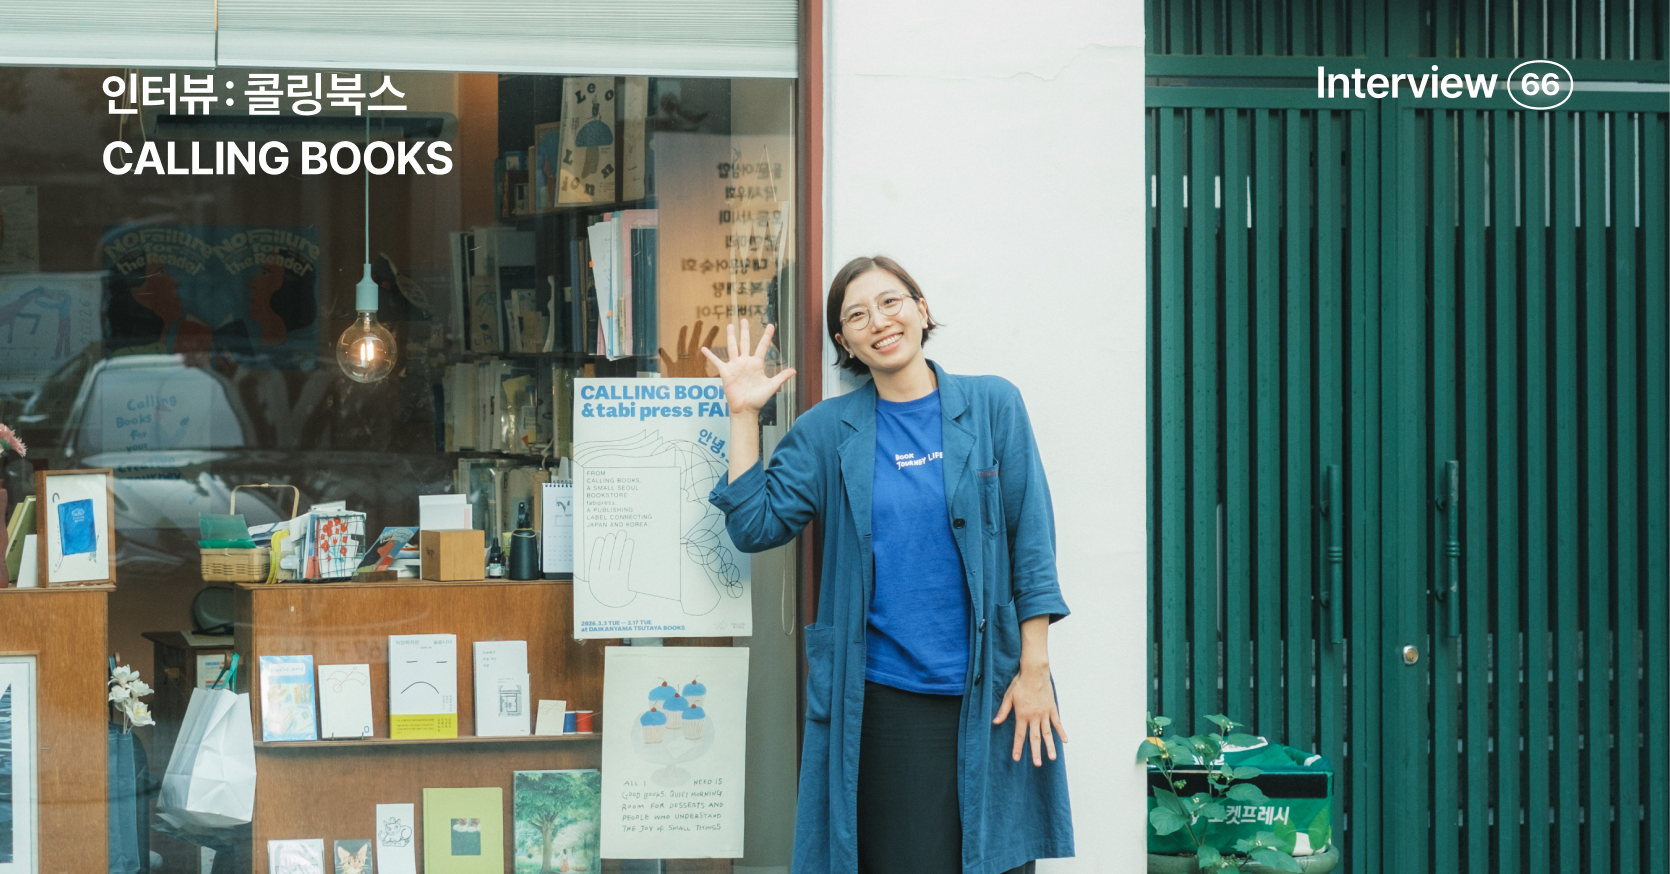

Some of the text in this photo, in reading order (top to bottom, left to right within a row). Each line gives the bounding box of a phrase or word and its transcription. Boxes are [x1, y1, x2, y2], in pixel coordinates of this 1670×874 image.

[575, 82, 614, 104] Leo
[144, 241, 181, 252] for
[116, 256, 146, 276] the
[224, 256, 253, 276] the
[581, 385, 670, 400] CALLING
[126, 394, 177, 412] Calling
[639, 405, 693, 421] press
[115, 414, 153, 430] Books
[928, 452, 943, 461] LIFE
[622, 791, 640, 799] GOOD
[670, 790, 689, 798] QUIET
[674, 812, 722, 820] UNDERSTAND
[695, 823, 721, 831] THINGS
